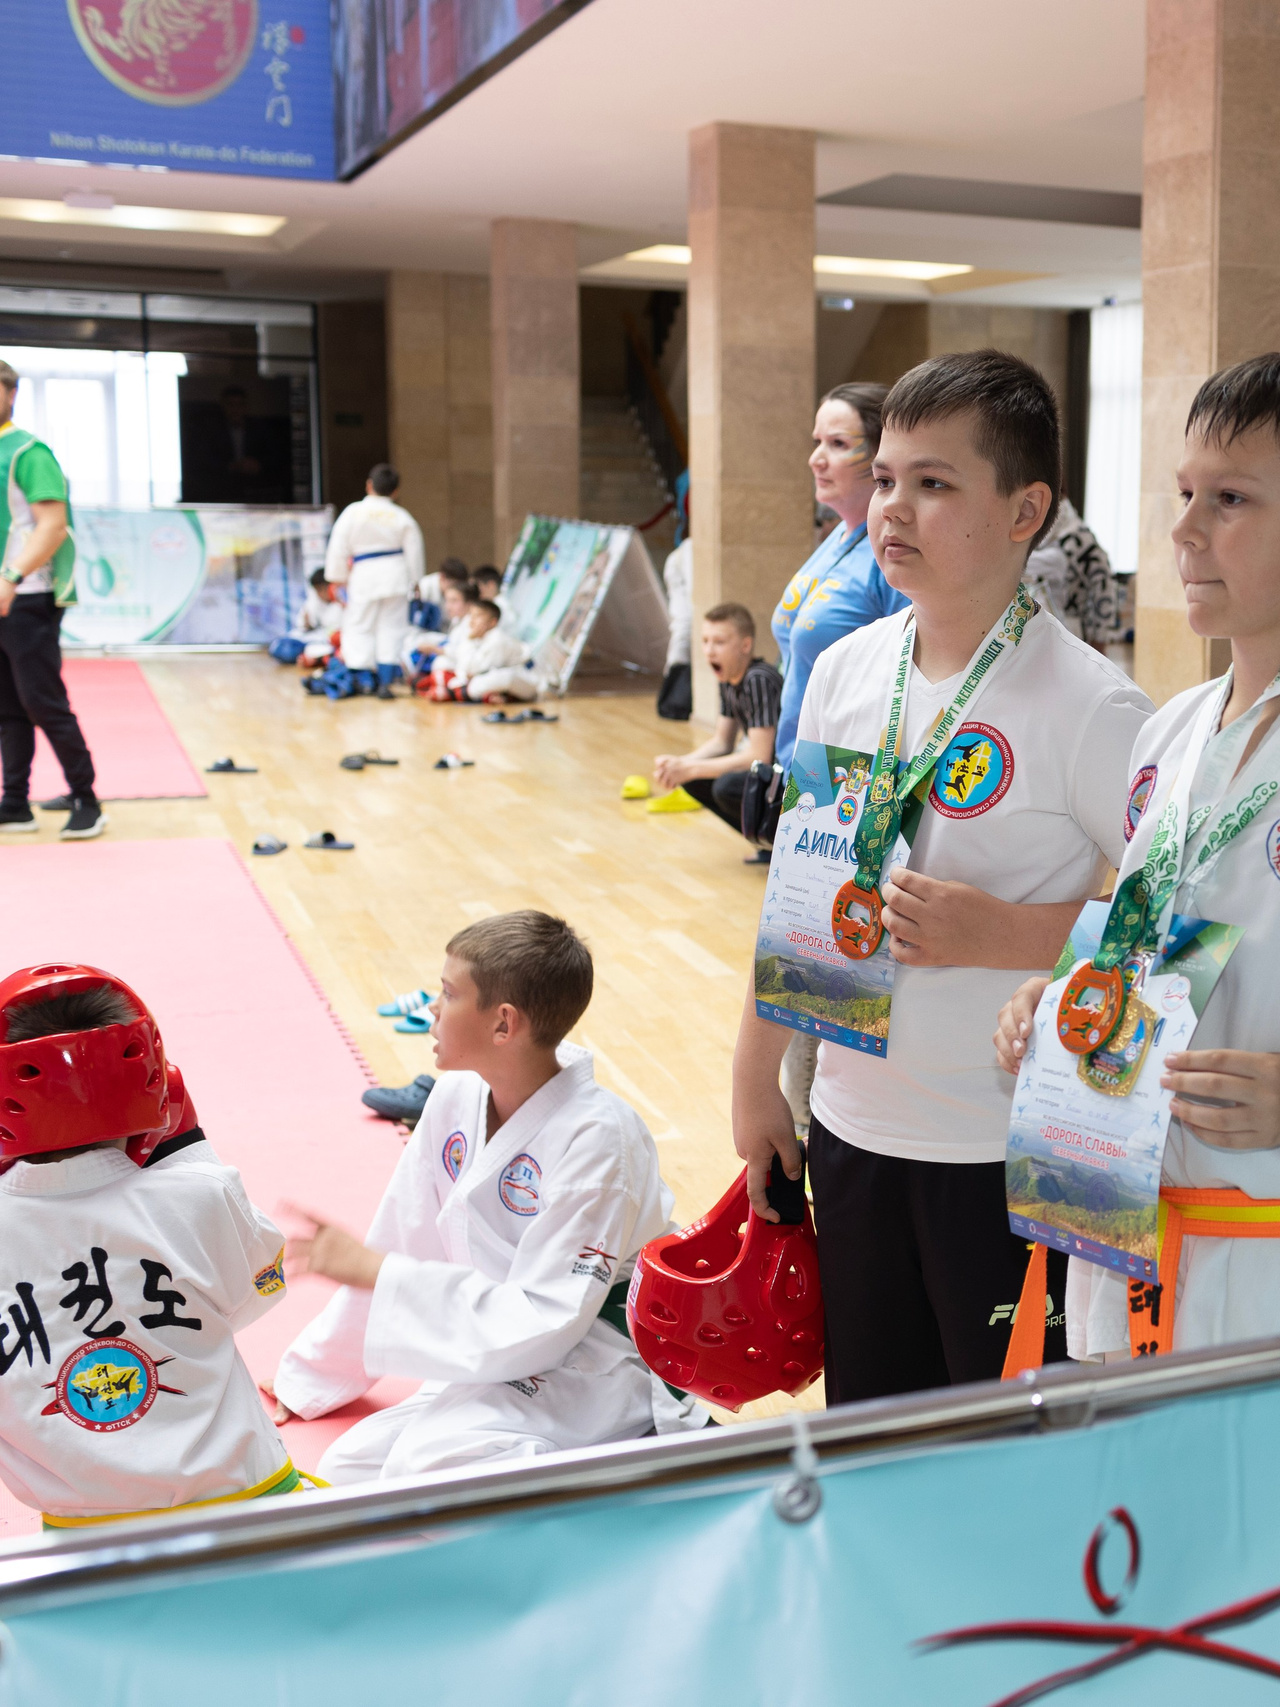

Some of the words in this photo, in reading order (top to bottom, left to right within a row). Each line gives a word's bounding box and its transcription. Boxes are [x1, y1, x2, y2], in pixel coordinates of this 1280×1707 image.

[50, 131, 95, 150] Nihon
[97, 134, 166, 156] Shotokan
[168, 141, 238, 163] Karate-do
[240, 145, 315, 168] Federation
[953, 639, 1006, 709] ЖЕЛЕЗНОВОДСК
[882, 696, 902, 769] ЖЕЛЕЗНОВОДСК
[980, 724, 1012, 766] ТРАДИЦИОННОГО
[794, 827, 860, 866] ДИПЛО
[785, 930, 824, 950] «ДОРОГА
[797, 947, 825, 962] СЕВЕРНЫЙ
[825, 954, 848, 968] КАВКАЗ
[1040, 1125, 1083, 1147] «ДОРОГА
[1085, 1136, 1127, 1158] СЛАВЫ»
[57, 1349, 86, 1398] ТРАДИЦИОННОГО
[85, 1339, 127, 1351] ТАЭКВОН-ДО
[127, 1341, 157, 1393] СТАВРОПОЛЬСКОГО
[105, 1418, 132, 1431] ФТТСК
